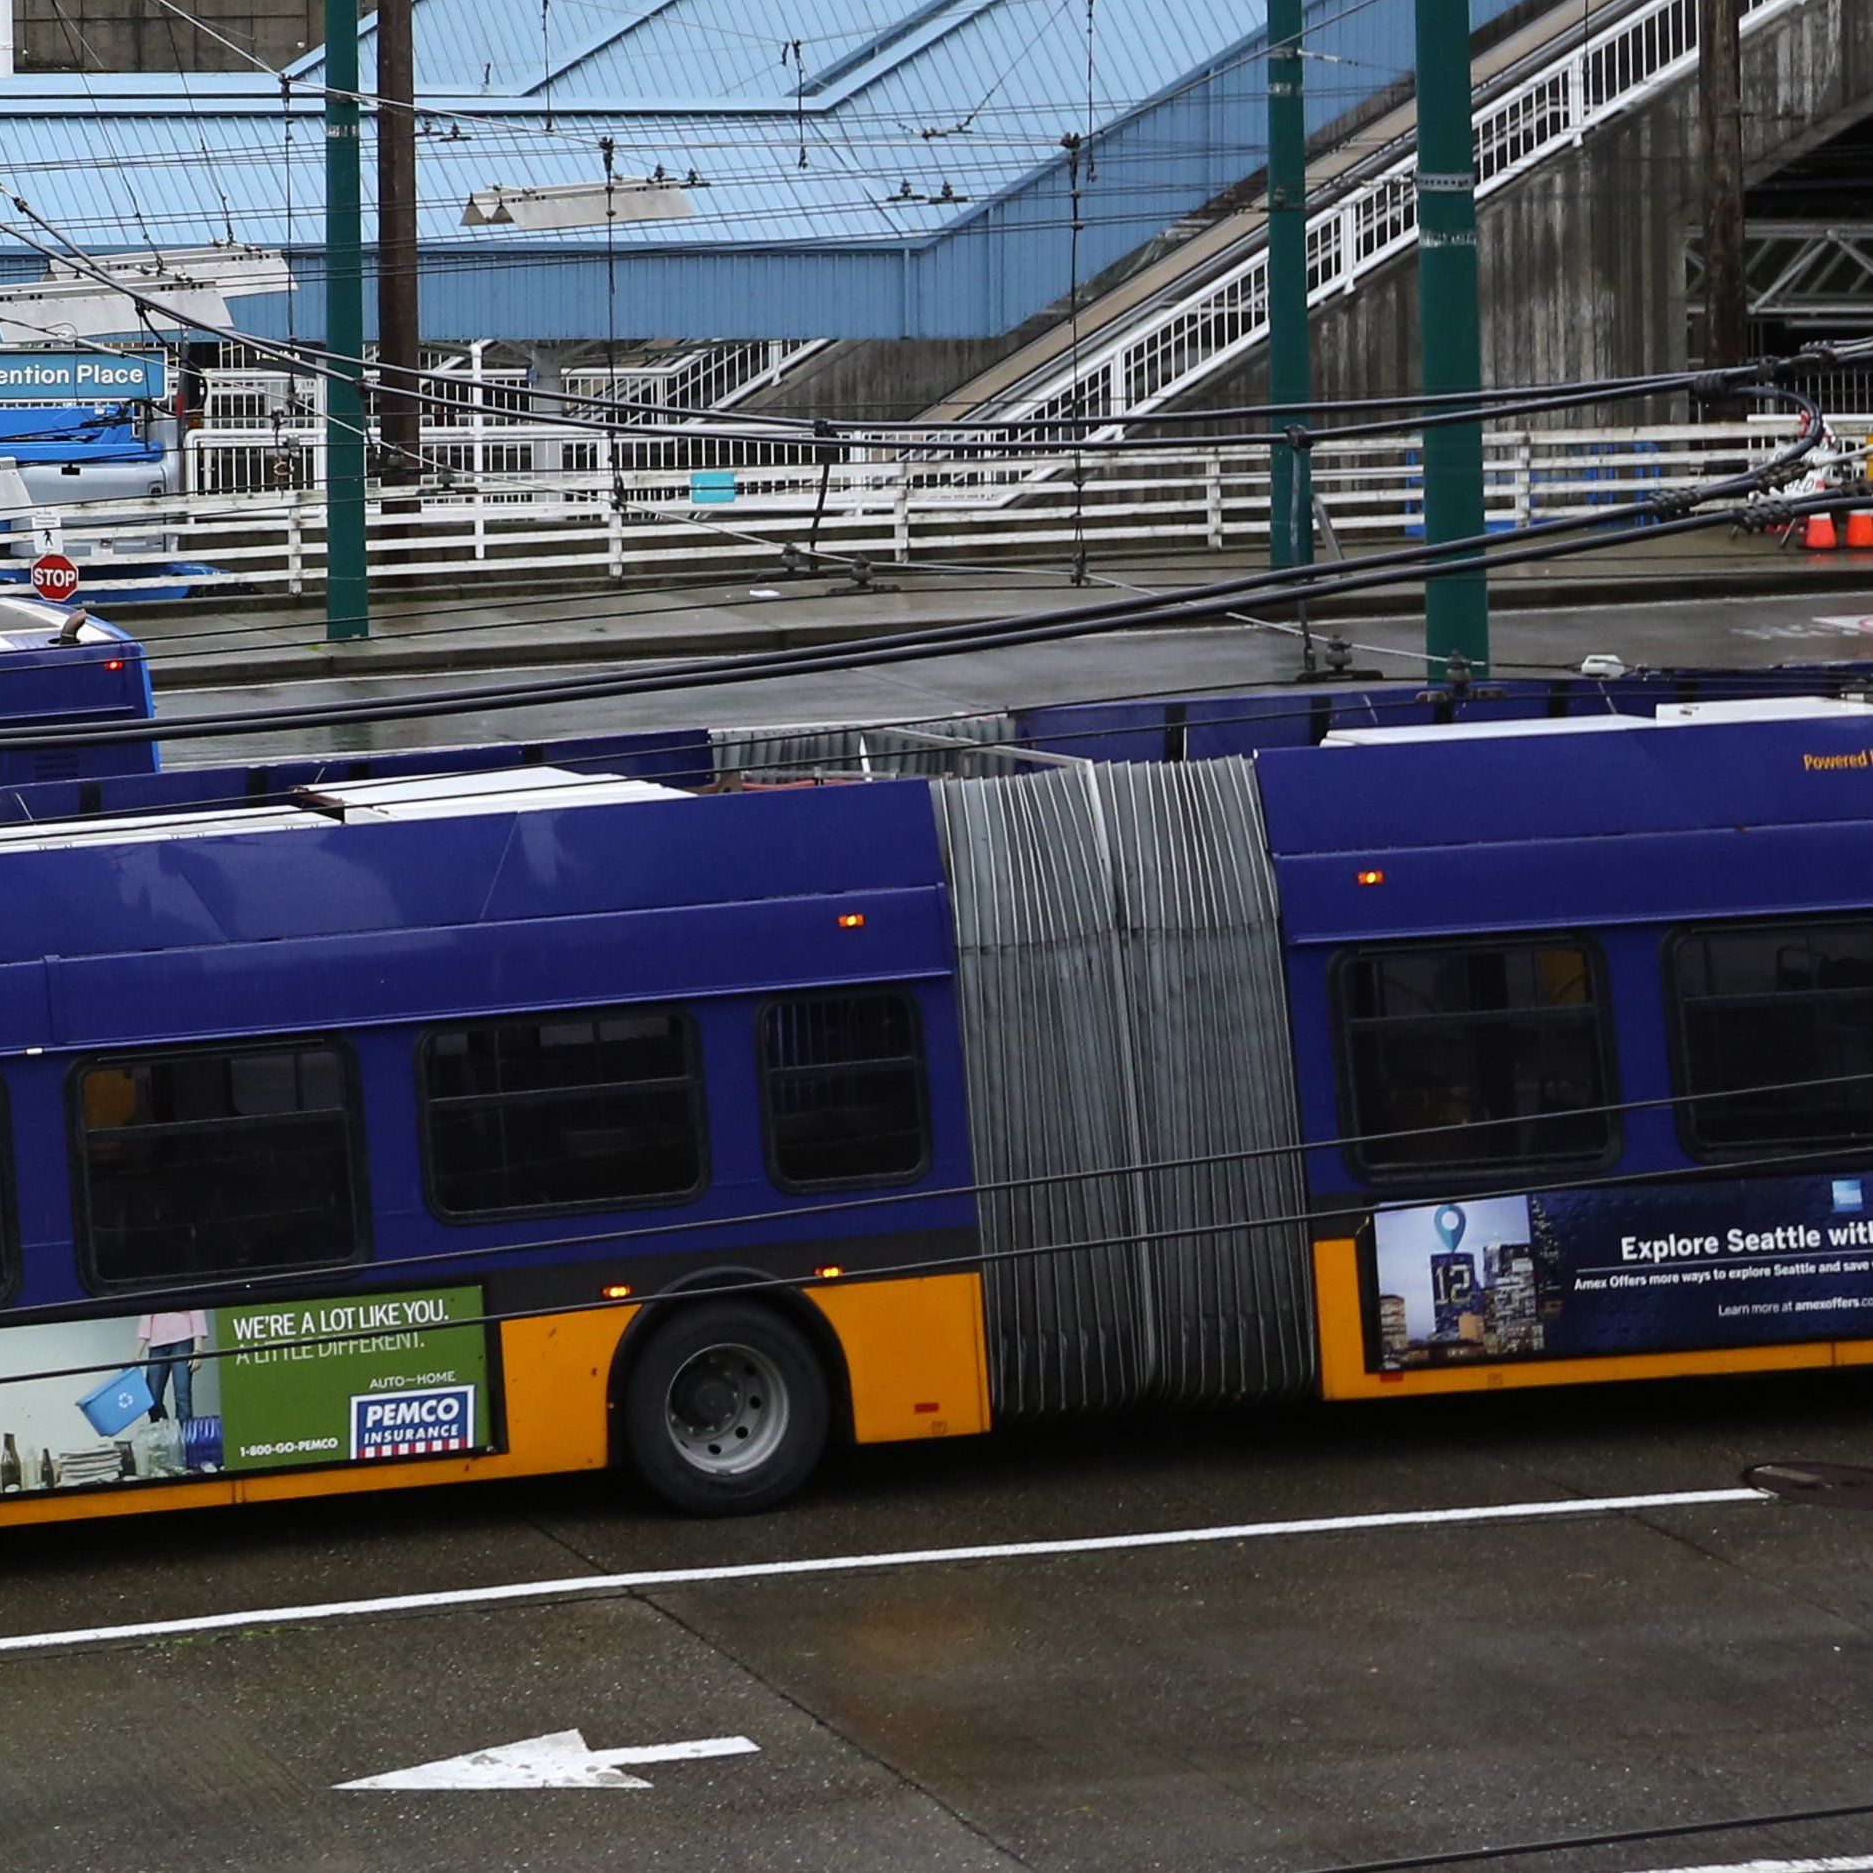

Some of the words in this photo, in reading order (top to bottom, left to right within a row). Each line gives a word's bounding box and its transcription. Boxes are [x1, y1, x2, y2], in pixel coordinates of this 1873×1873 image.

[77, 364, 144, 385] Place
[34, 567, 75, 588] STOP
[1803, 749, 1868, 771] Powered
[1621, 1234, 1719, 1263] Explore
[1727, 1225, 1821, 1252] Seattle
[1435, 1264, 1472, 1305] 12
[1574, 1278, 1607, 1291] Amex
[1609, 1275, 1646, 1288] Offers
[1649, 1274, 1679, 1285] more
[1681, 1270, 1711, 1285] ways
[1713, 1268, 1727, 1280] to
[1729, 1265, 1771, 1281] explore
[1774, 1263, 1816, 1276] Seattle
[1818, 1261, 1841, 1273] and
[1843, 1260, 1869, 1271] save
[233, 1313, 296, 1340] WE'RE
[301, 1312, 316, 1334] A
[319, 1307, 356, 1332] LOT
[359, 1303, 402, 1328] LIKE
[403, 1299, 450, 1324] YOU.
[1718, 1304, 1749, 1317] Learn
[1752, 1302, 1779, 1313] more
[1781, 1301, 1792, 1312] at
[236, 1343, 250, 1365] A
[255, 1339, 314, 1364] LITTLE
[365, 1397, 460, 1428] PEMCO
[364, 1423, 459, 1444] INSURANCE
[240, 1437, 339, 1457] 1-800-GO-PEMCO
